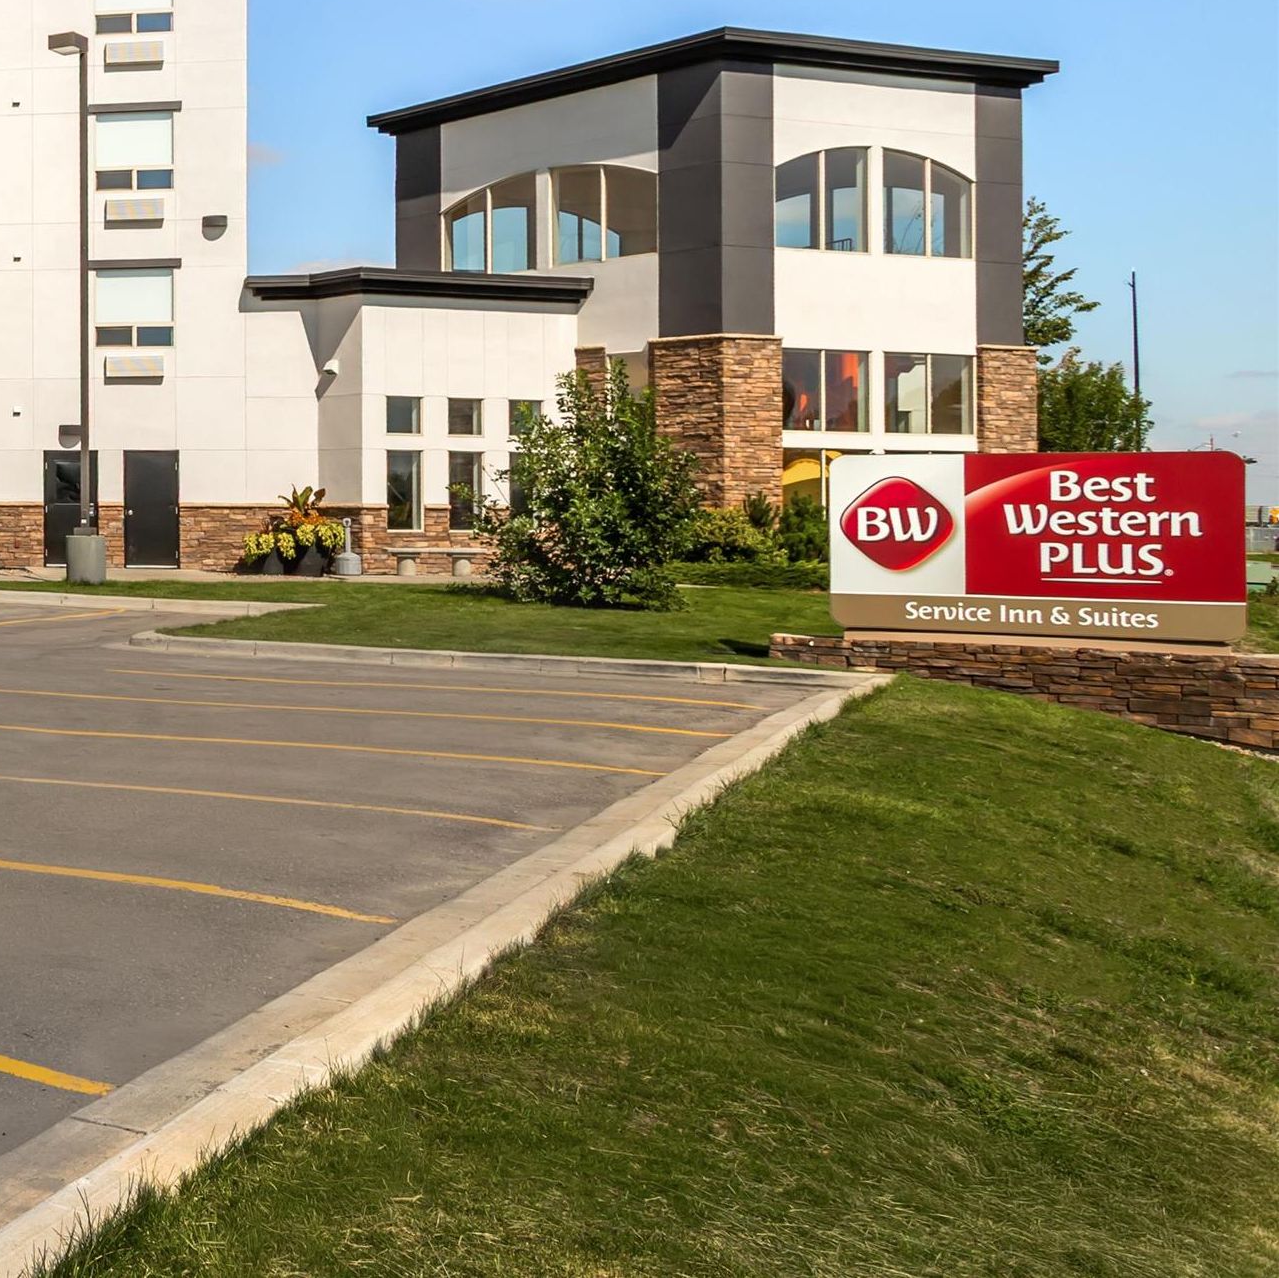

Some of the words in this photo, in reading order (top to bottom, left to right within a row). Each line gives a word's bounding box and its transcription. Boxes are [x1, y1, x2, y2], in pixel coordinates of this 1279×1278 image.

[1050, 470, 1156, 502] Best
[856, 506, 938, 542] BW
[1003, 504, 1203, 537] Western
[905, 601, 991, 622] Service
[1000, 604, 1042, 624] Inn
[1050, 607, 1070, 625] &
[1078, 608, 1159, 628] Suites
